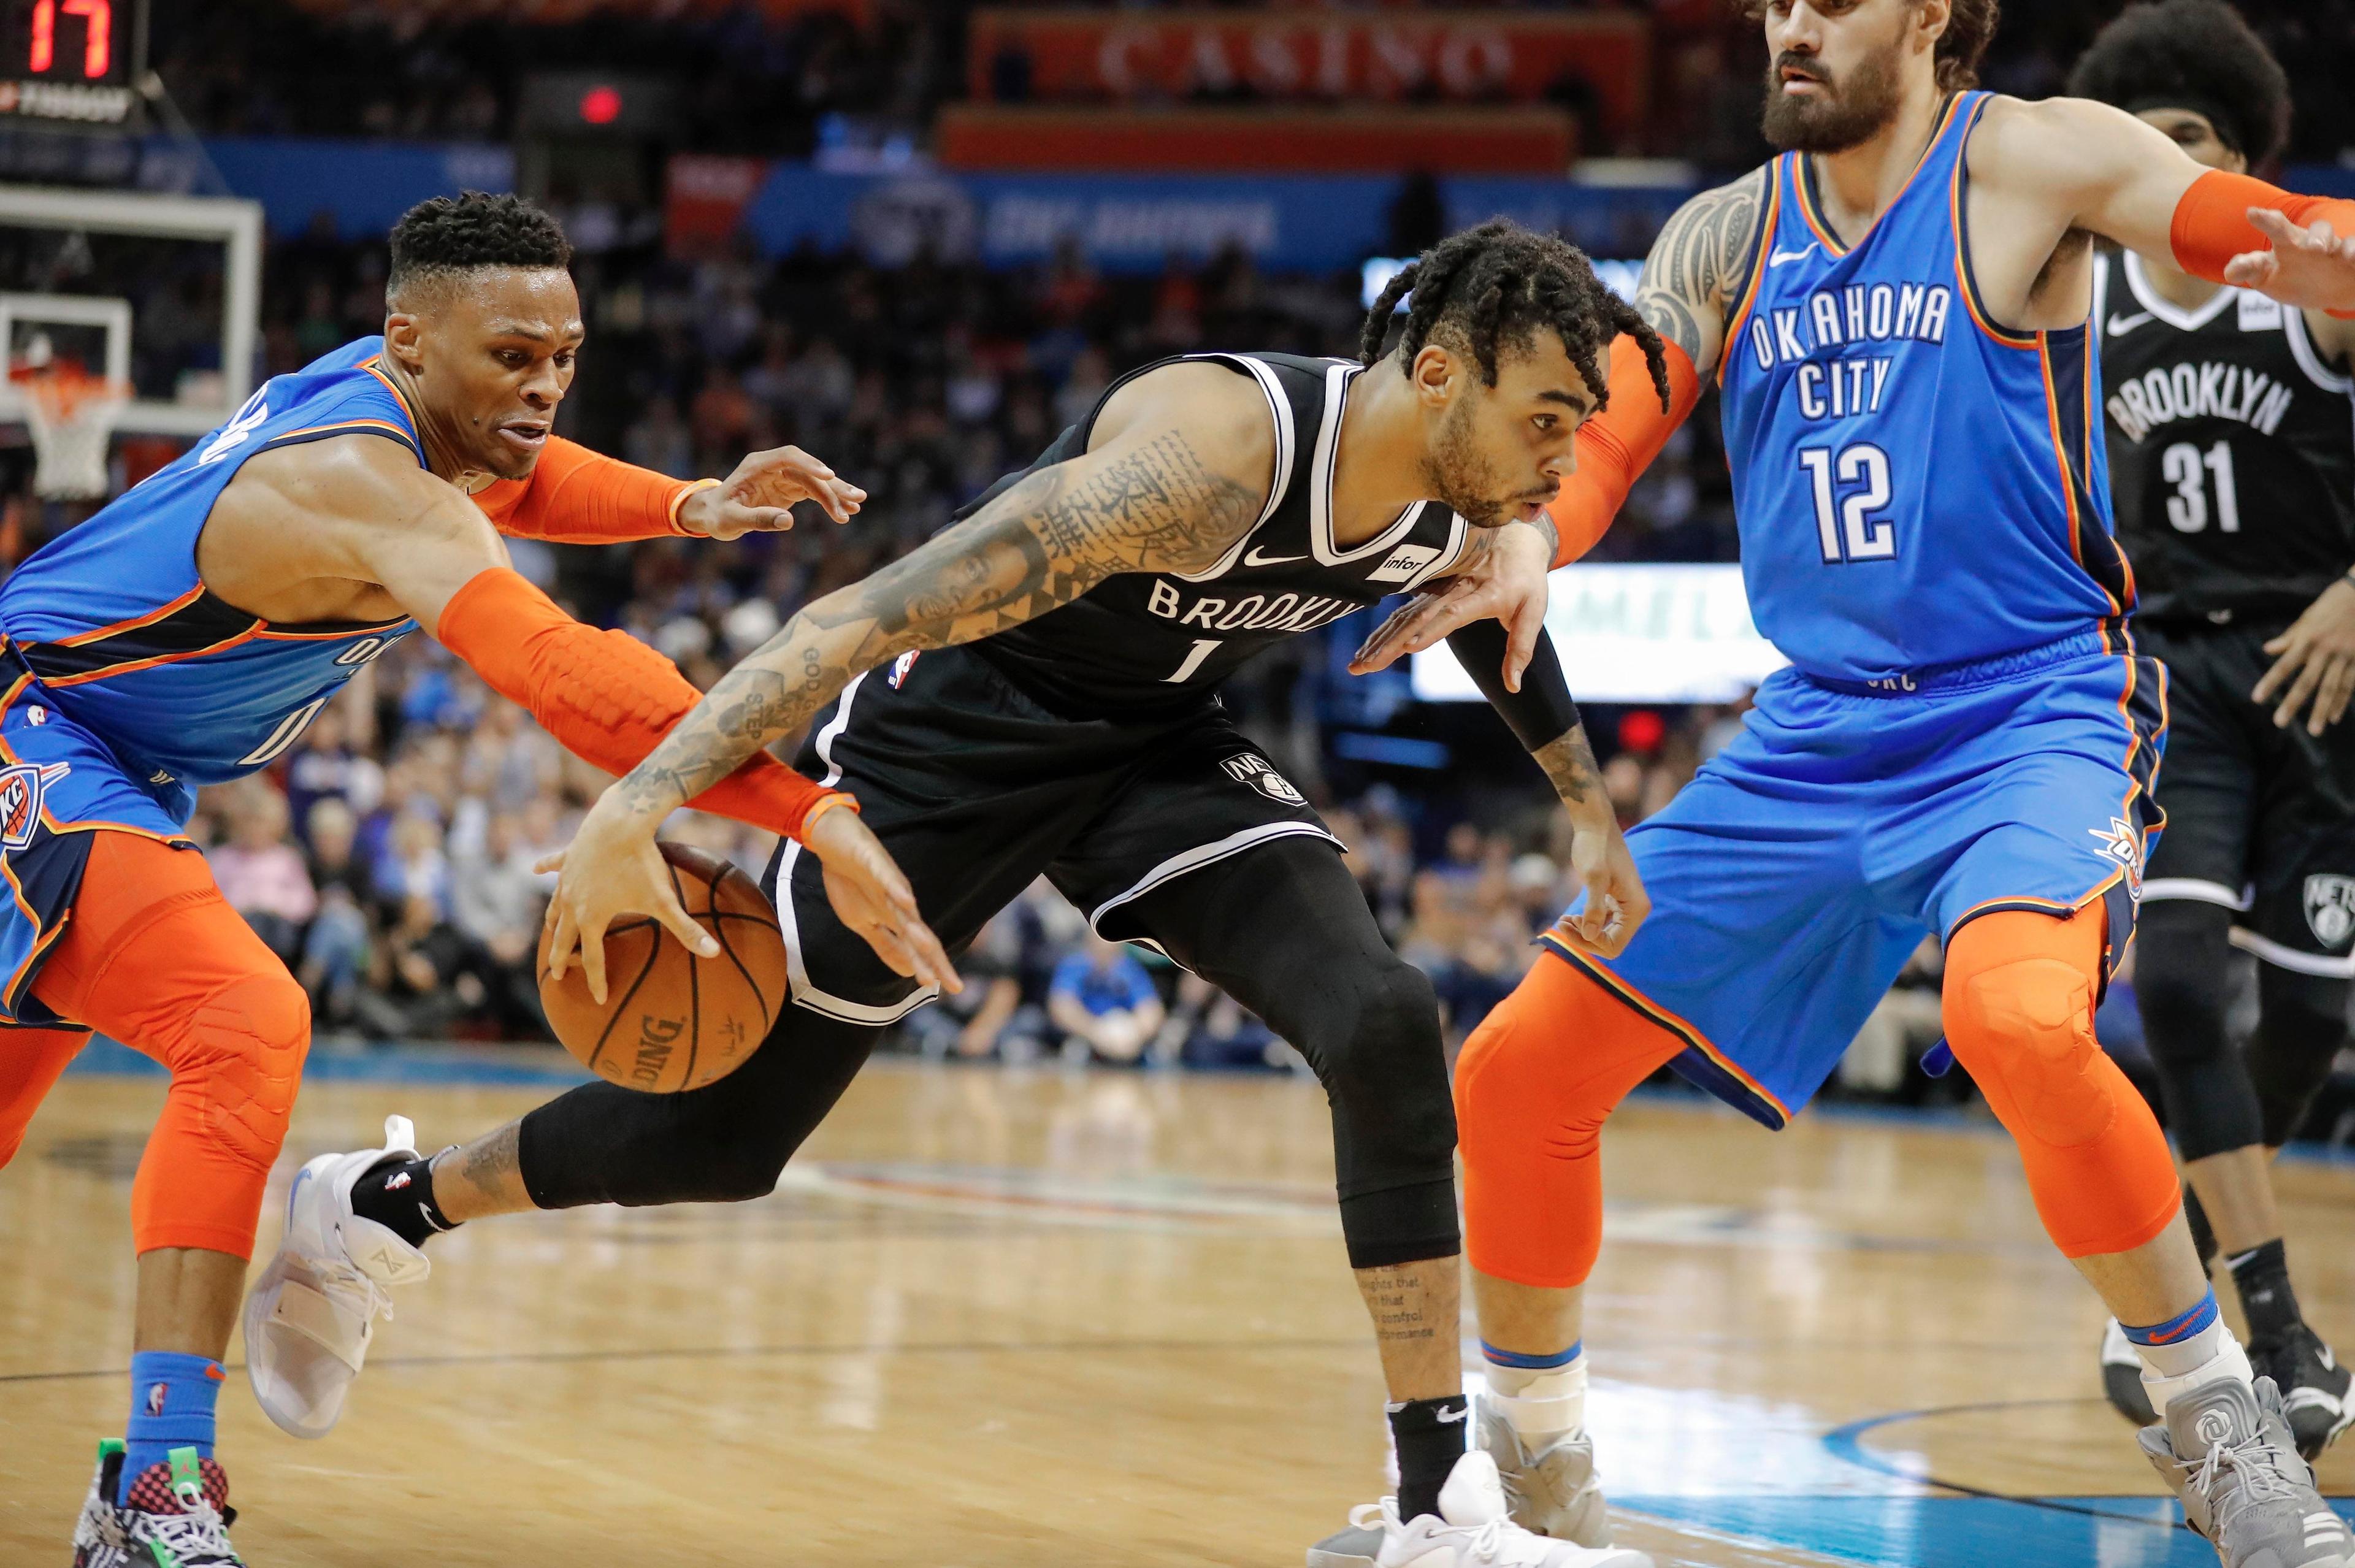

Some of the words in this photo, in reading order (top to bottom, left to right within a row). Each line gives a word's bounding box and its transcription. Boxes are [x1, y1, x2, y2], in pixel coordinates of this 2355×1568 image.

[1098, 26, 1514, 94] CASINO
[1751, 281, 1951, 372] OKAHOMA
[1796, 356, 1893, 421] CITY
[2106, 361, 2294, 445] BROOKLYN
[1799, 440, 1897, 565] 12
[2162, 440, 2240, 535] 31
[1383, 556, 1423, 570] infor
[1147, 578, 1365, 633] BROOKLY
[1158, 639, 1224, 683] 1
[632, 1015, 684, 1084] DING
